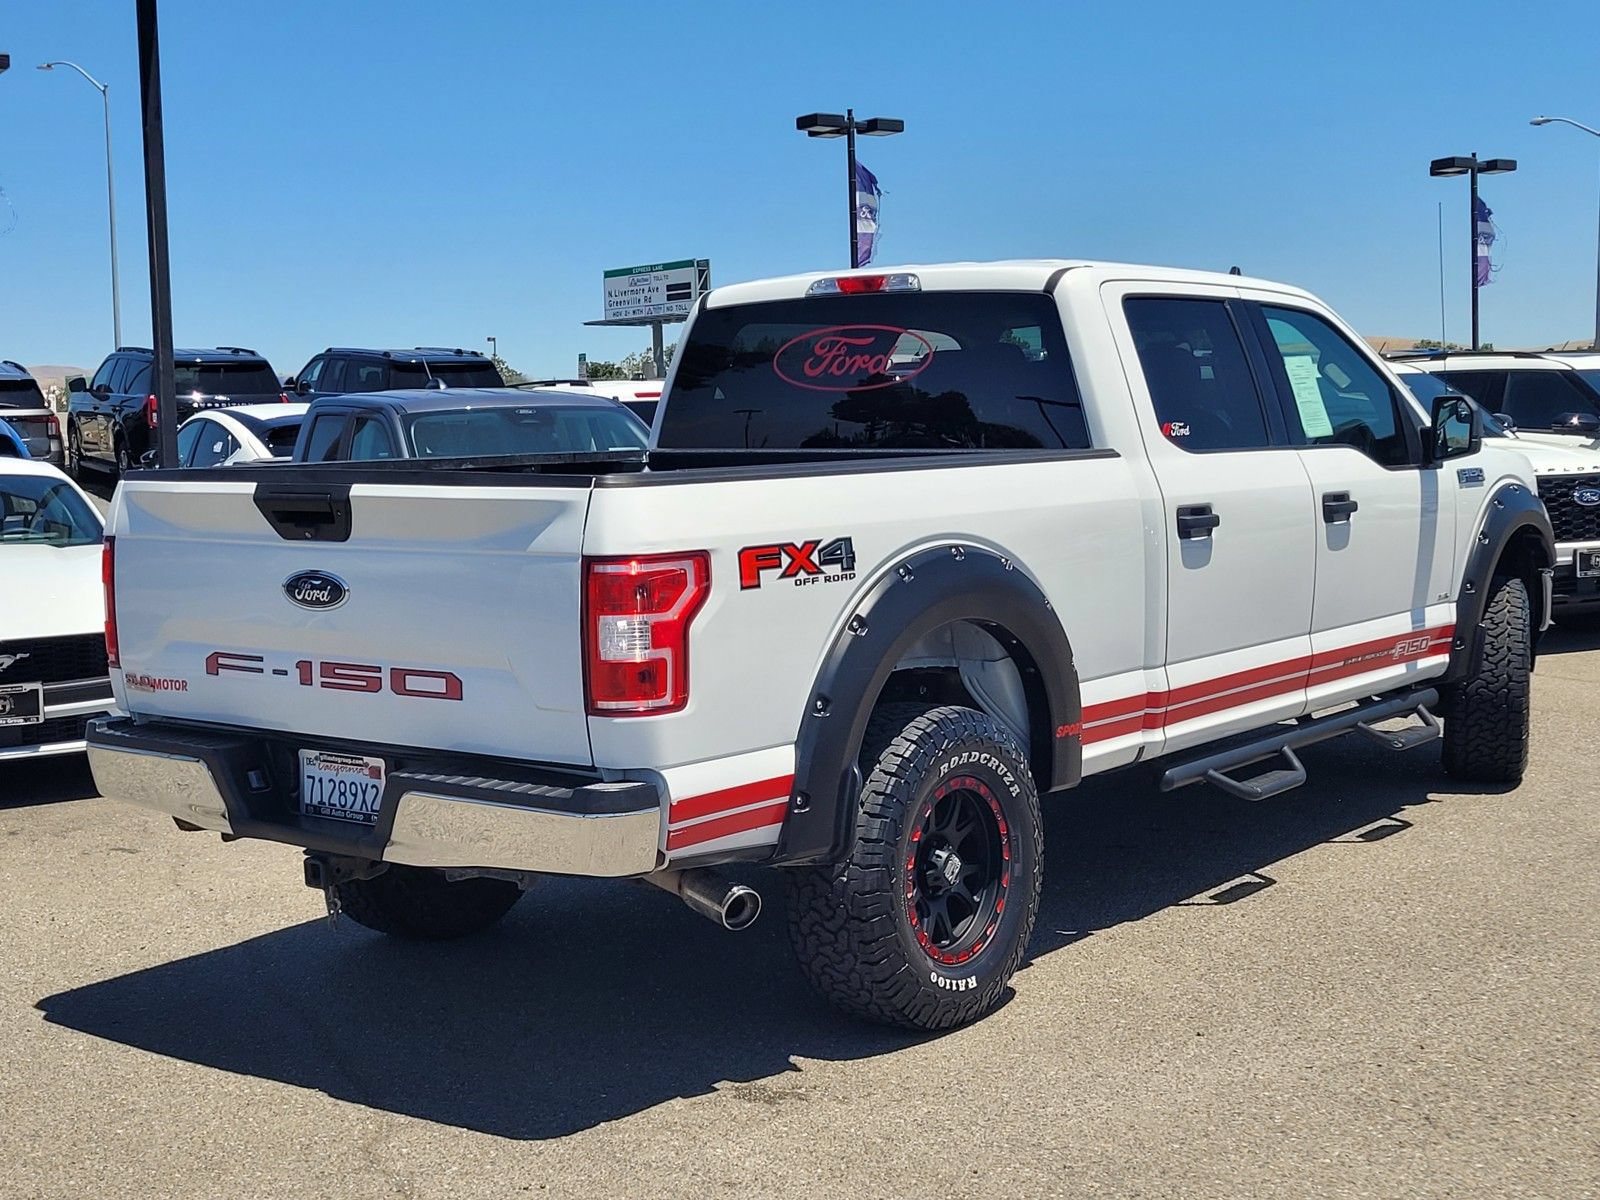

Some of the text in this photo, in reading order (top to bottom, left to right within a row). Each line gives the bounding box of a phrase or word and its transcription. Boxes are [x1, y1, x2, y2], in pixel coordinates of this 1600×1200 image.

[608, 285, 660, 298] N Livermore Ave
[608, 295, 652, 308] Greenville Rd
[612, 310, 622, 318] HOV
[803, 336, 897, 377] Ford
[1170, 422, 1191, 436] Ford
[737, 536, 856, 591] FX4
[794, 572, 857, 587] OFF ROAD
[294, 578, 332, 602] Ford
[152, 678, 189, 692] MOTOR
[205, 651, 464, 701] F-150
[939, 751, 1021, 798] ROADCRUZA
[306, 775, 380, 812] 71289X2
[331, 808, 345, 818] Auto
[345, 812, 364, 821] Group
[930, 971, 978, 992] RA1100
